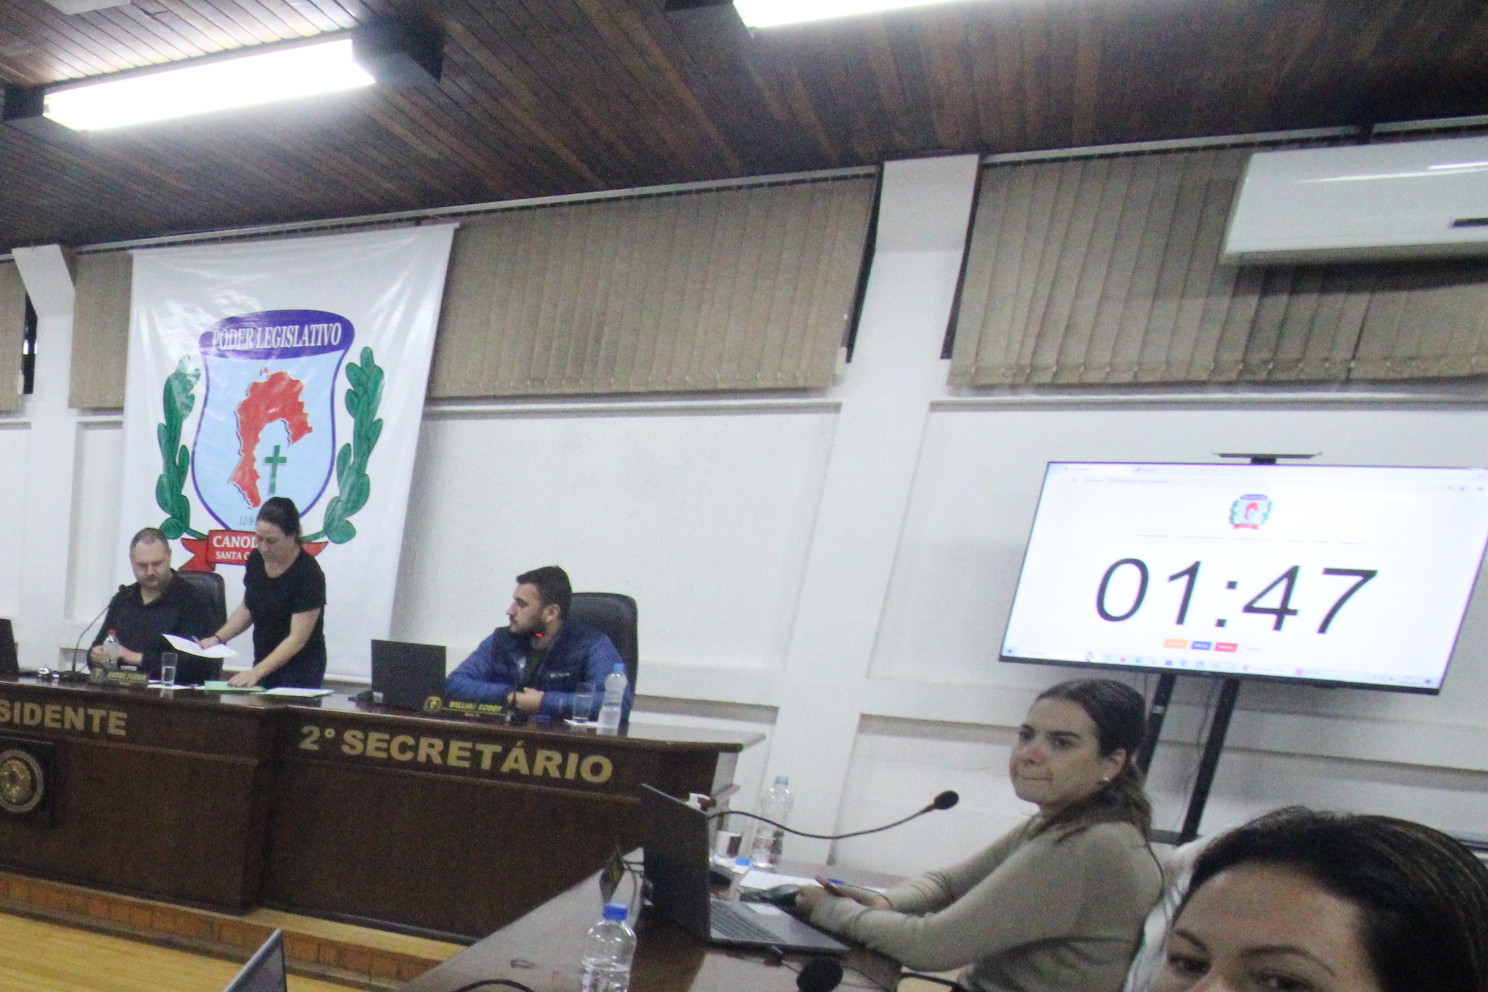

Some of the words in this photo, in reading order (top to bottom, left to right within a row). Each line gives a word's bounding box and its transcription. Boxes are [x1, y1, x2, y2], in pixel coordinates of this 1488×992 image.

[211, 328, 253, 350] PODER
[255, 322, 342, 348] LEGISLATIVO
[215, 551, 242, 560] SANTA
[1096, 557, 1379, 634] 01:47
[340, 729, 613, 784] SECRETÁRIO
